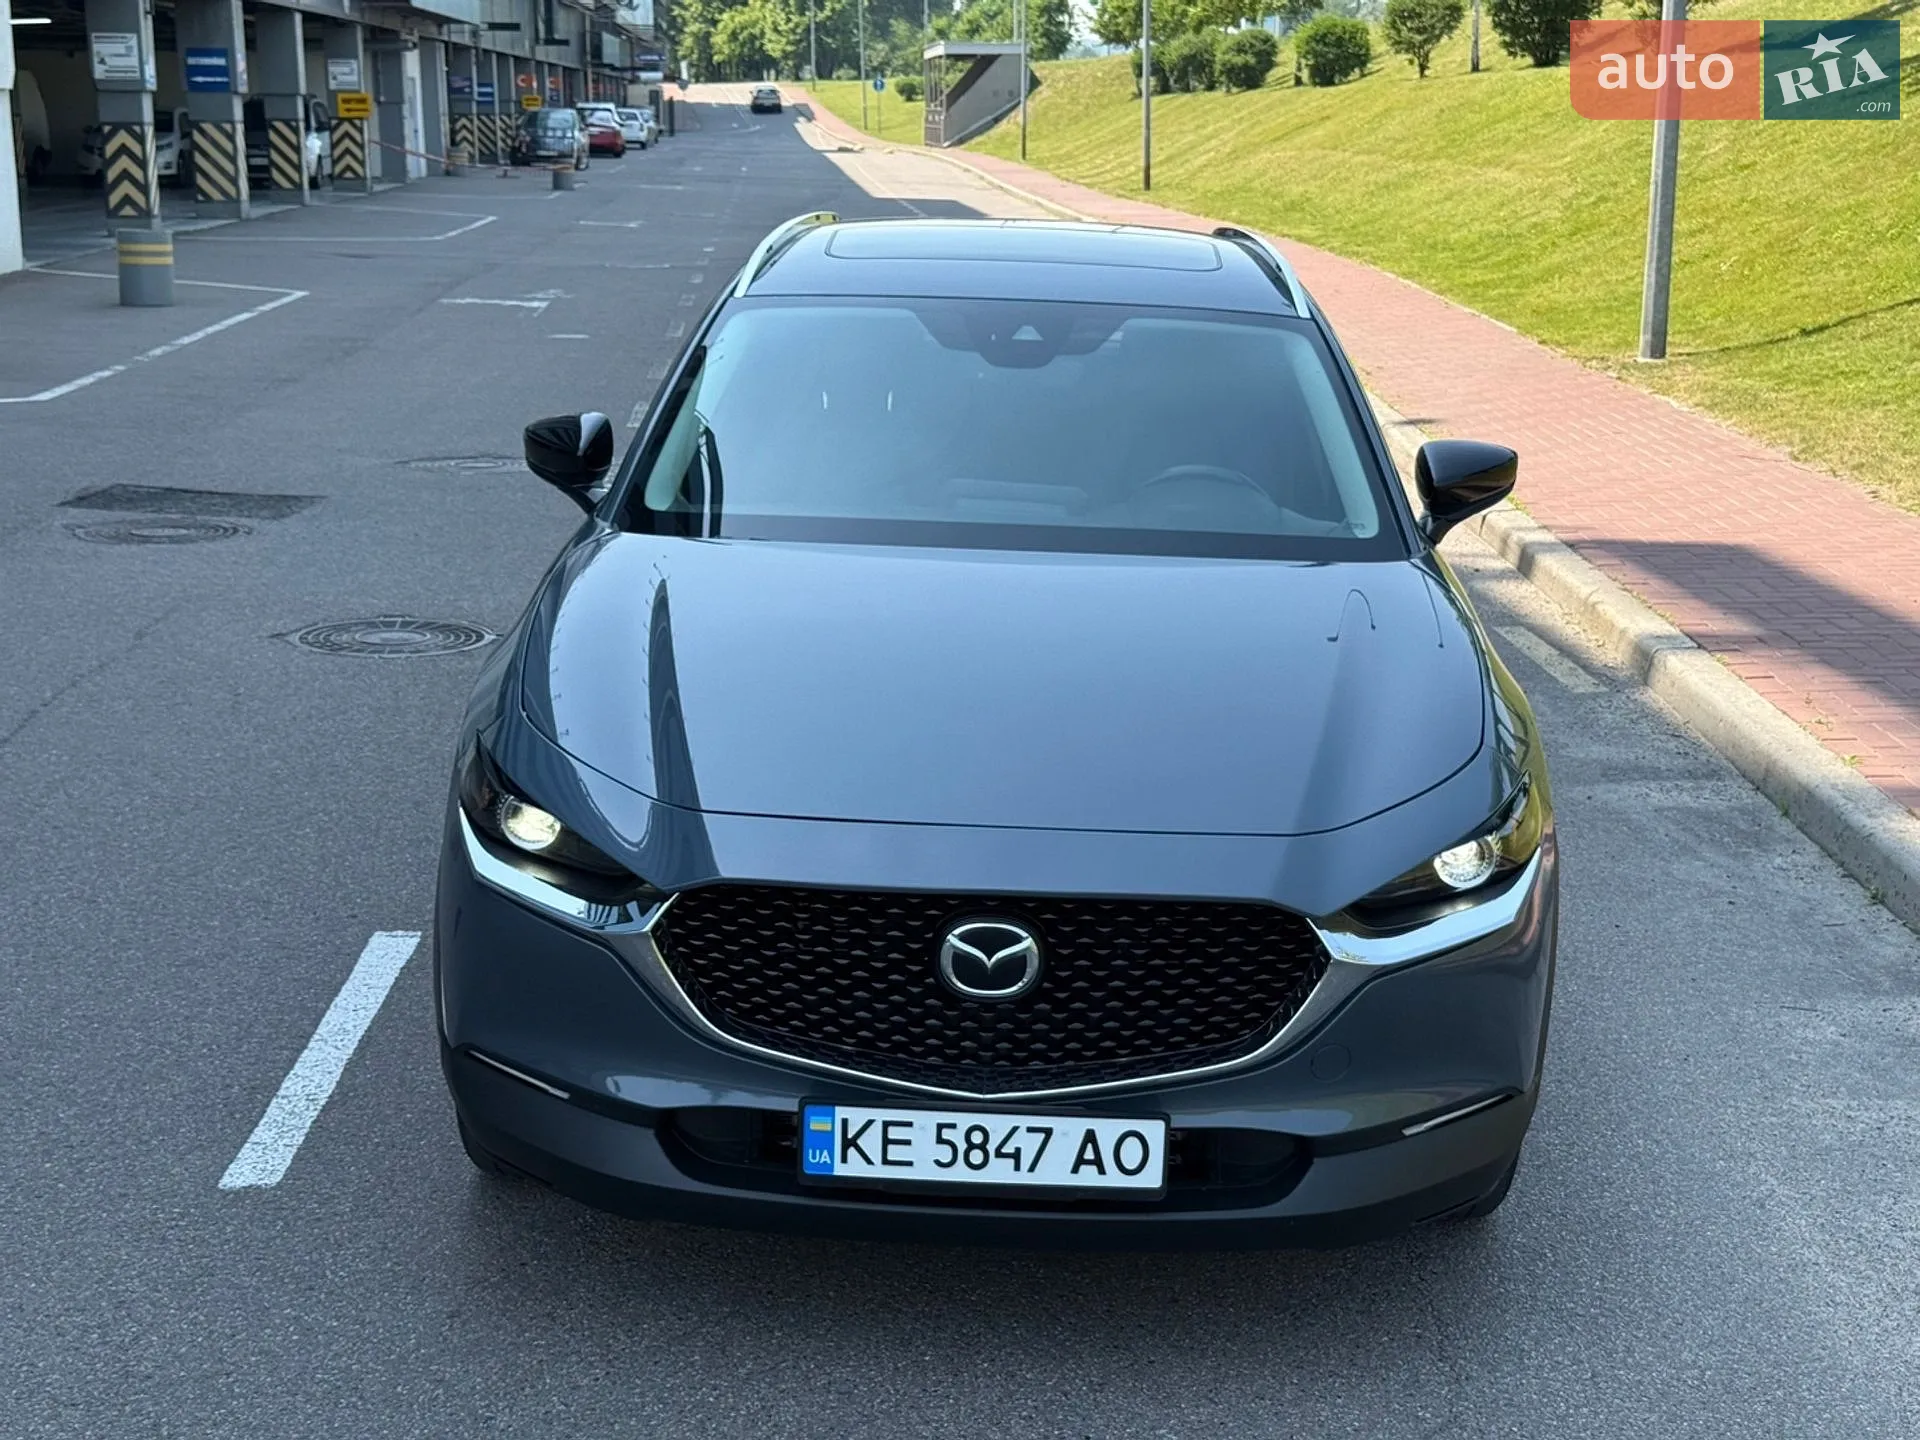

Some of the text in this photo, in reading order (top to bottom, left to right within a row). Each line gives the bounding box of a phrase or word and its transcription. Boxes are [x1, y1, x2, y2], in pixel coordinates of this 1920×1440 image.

[808, 1148, 832, 1165] UA
[839, 1117, 1150, 1177] KE 5847 AO
